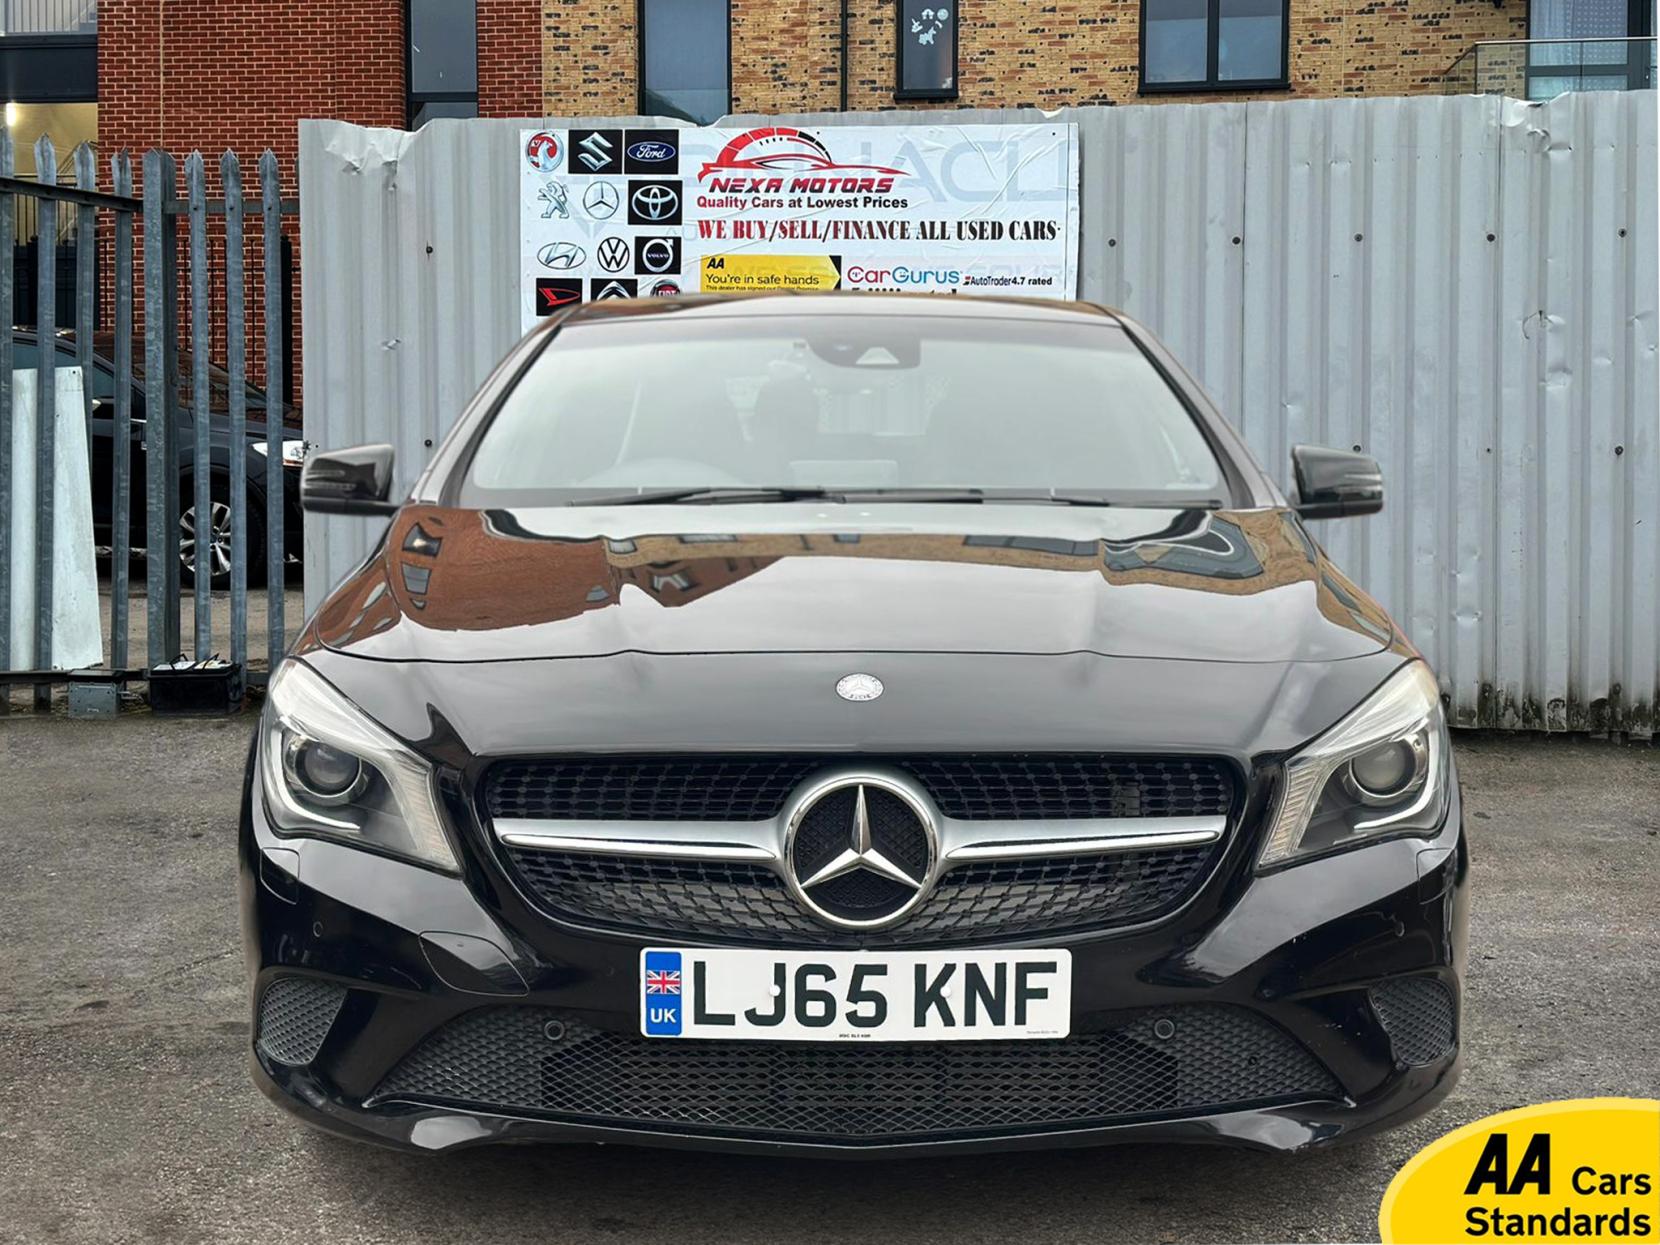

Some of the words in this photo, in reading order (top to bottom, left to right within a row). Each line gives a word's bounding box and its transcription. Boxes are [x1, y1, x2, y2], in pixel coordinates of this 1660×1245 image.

[636, 144, 666, 158] Ford
[709, 178, 783, 193] NEXA
[789, 178, 895, 193] MOTORS
[697, 196, 747, 210] Quality
[751, 196, 783, 208] Cars
[789, 197, 803, 208] at
[807, 196, 858, 208] Lowest
[863, 196, 908, 208] Prices
[697, 220, 726, 239] WE
[733, 220, 910, 242] BUY/SELL/FINANCE
[916, 221, 950, 240] ALL
[956, 220, 1003, 240] USED
[1009, 220, 1056, 240] CARS
[706, 258, 725, 269] AA
[706, 274, 741, 284] You're
[744, 274, 754, 284] in
[757, 274, 781, 284] safe
[784, 275, 819, 285] hands
[847, 266, 960, 284] CarGurus
[1028, 277, 1052, 285] rated
[693, 961, 888, 1028] LJ65
[914, 961, 1058, 1028] KNF
[650, 1008, 676, 1023] UK
